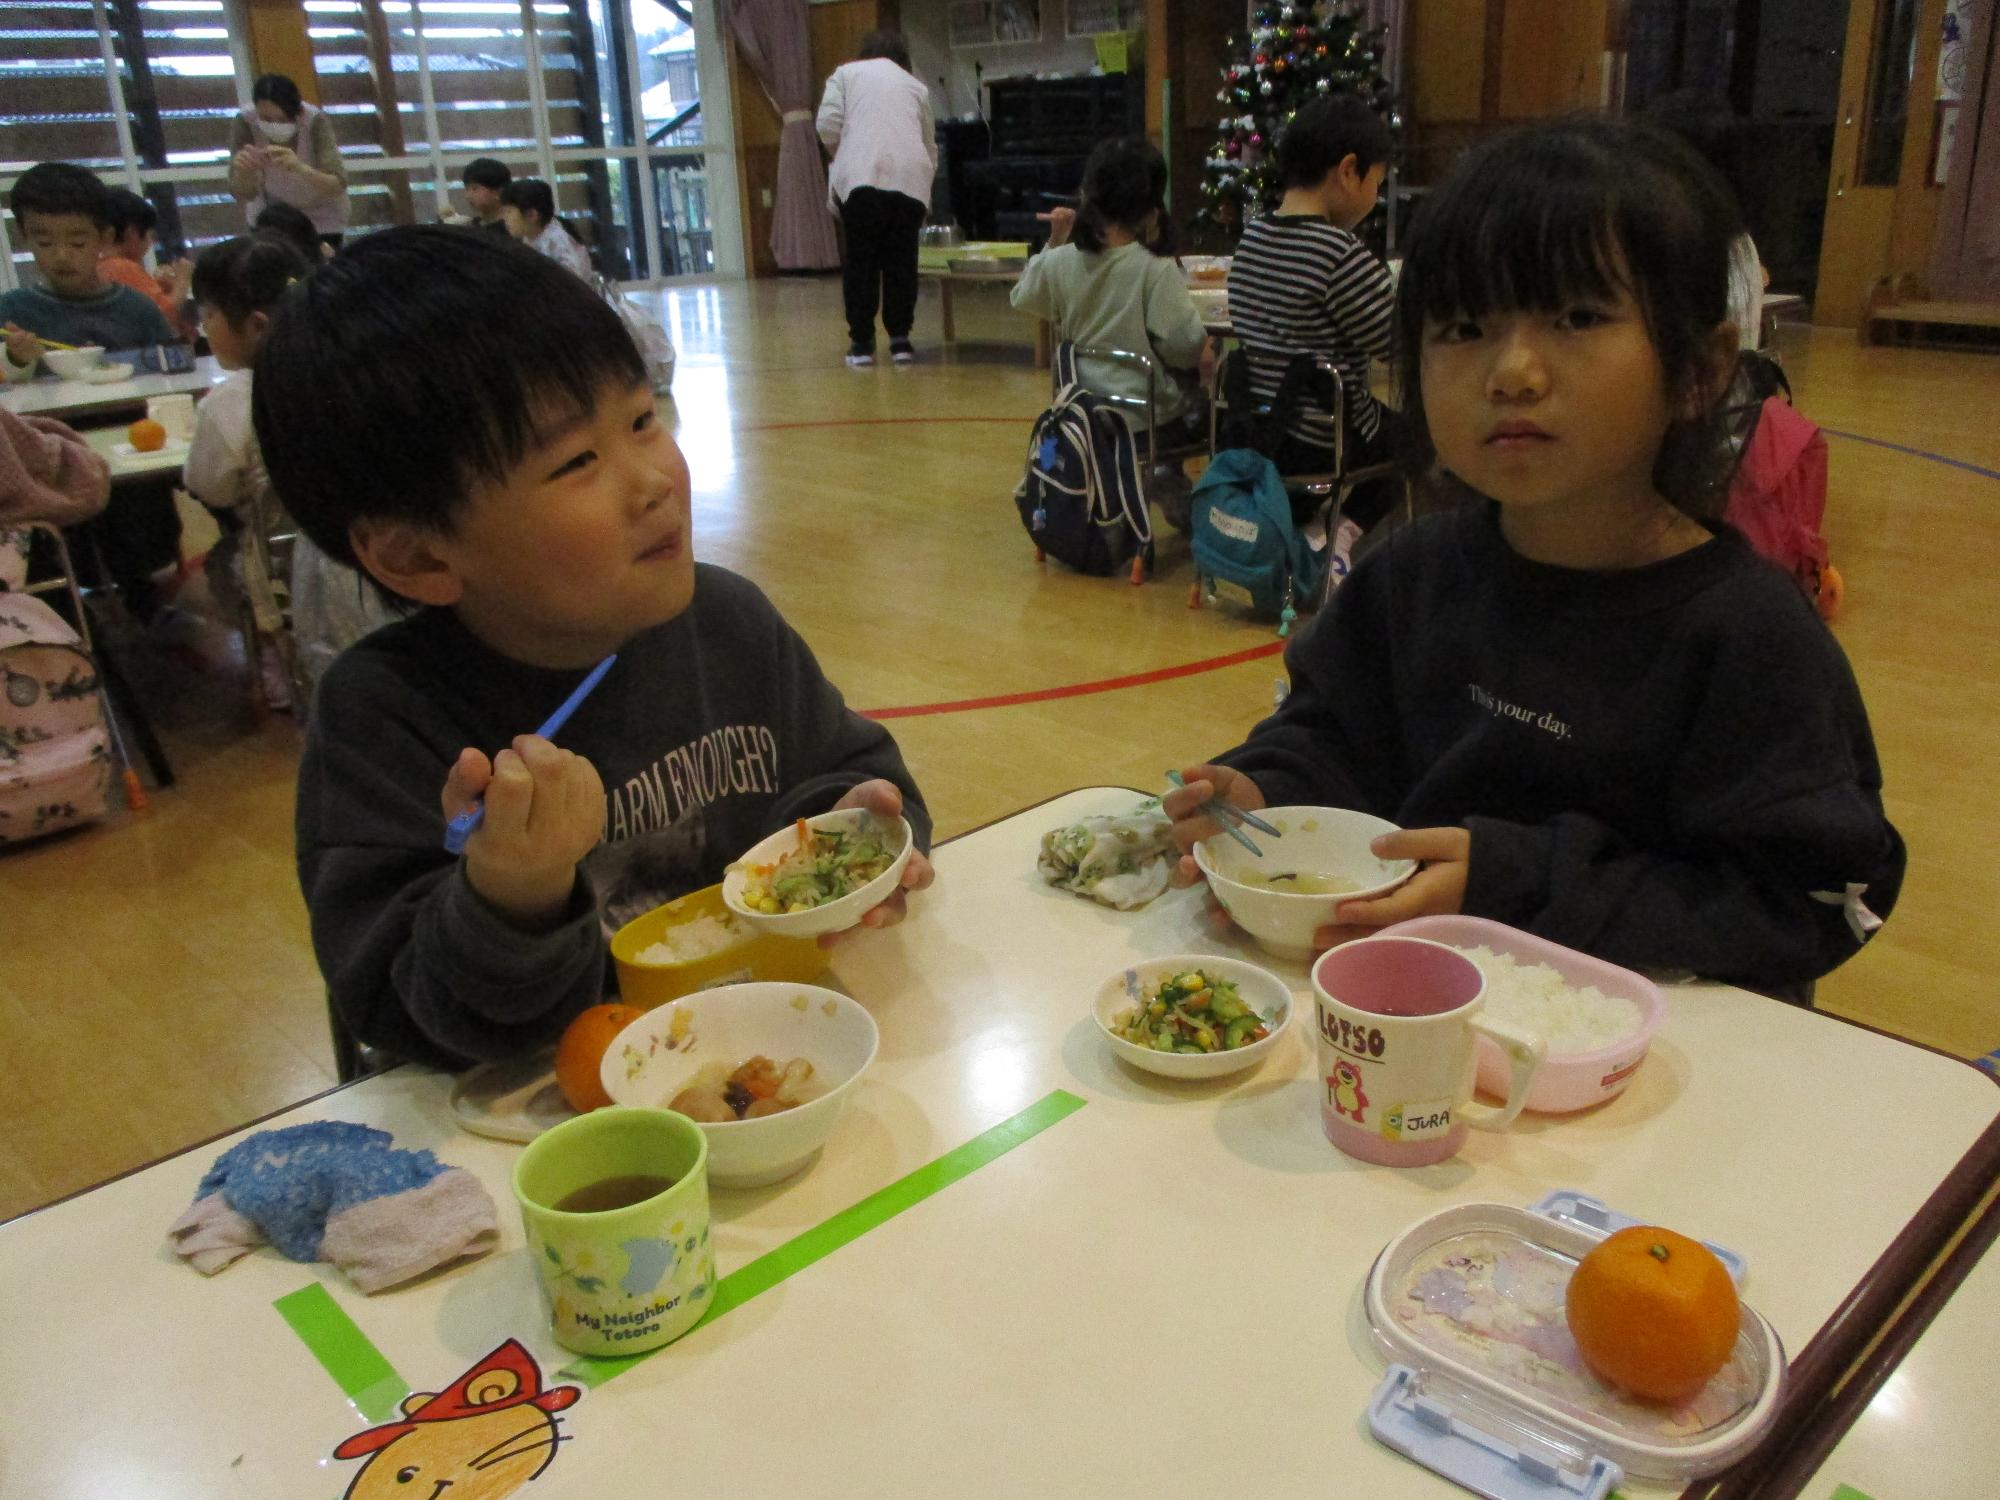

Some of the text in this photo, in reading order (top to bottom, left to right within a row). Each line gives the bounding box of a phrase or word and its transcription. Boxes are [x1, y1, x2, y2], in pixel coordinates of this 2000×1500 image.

[1494, 700, 1537, 723] your
[1537, 712, 1572, 740] day.
[602, 725, 779, 844] ARM ENOUGH?
[575, 1295, 681, 1330] My Neighbor
[602, 1322, 661, 1342] Totoro
